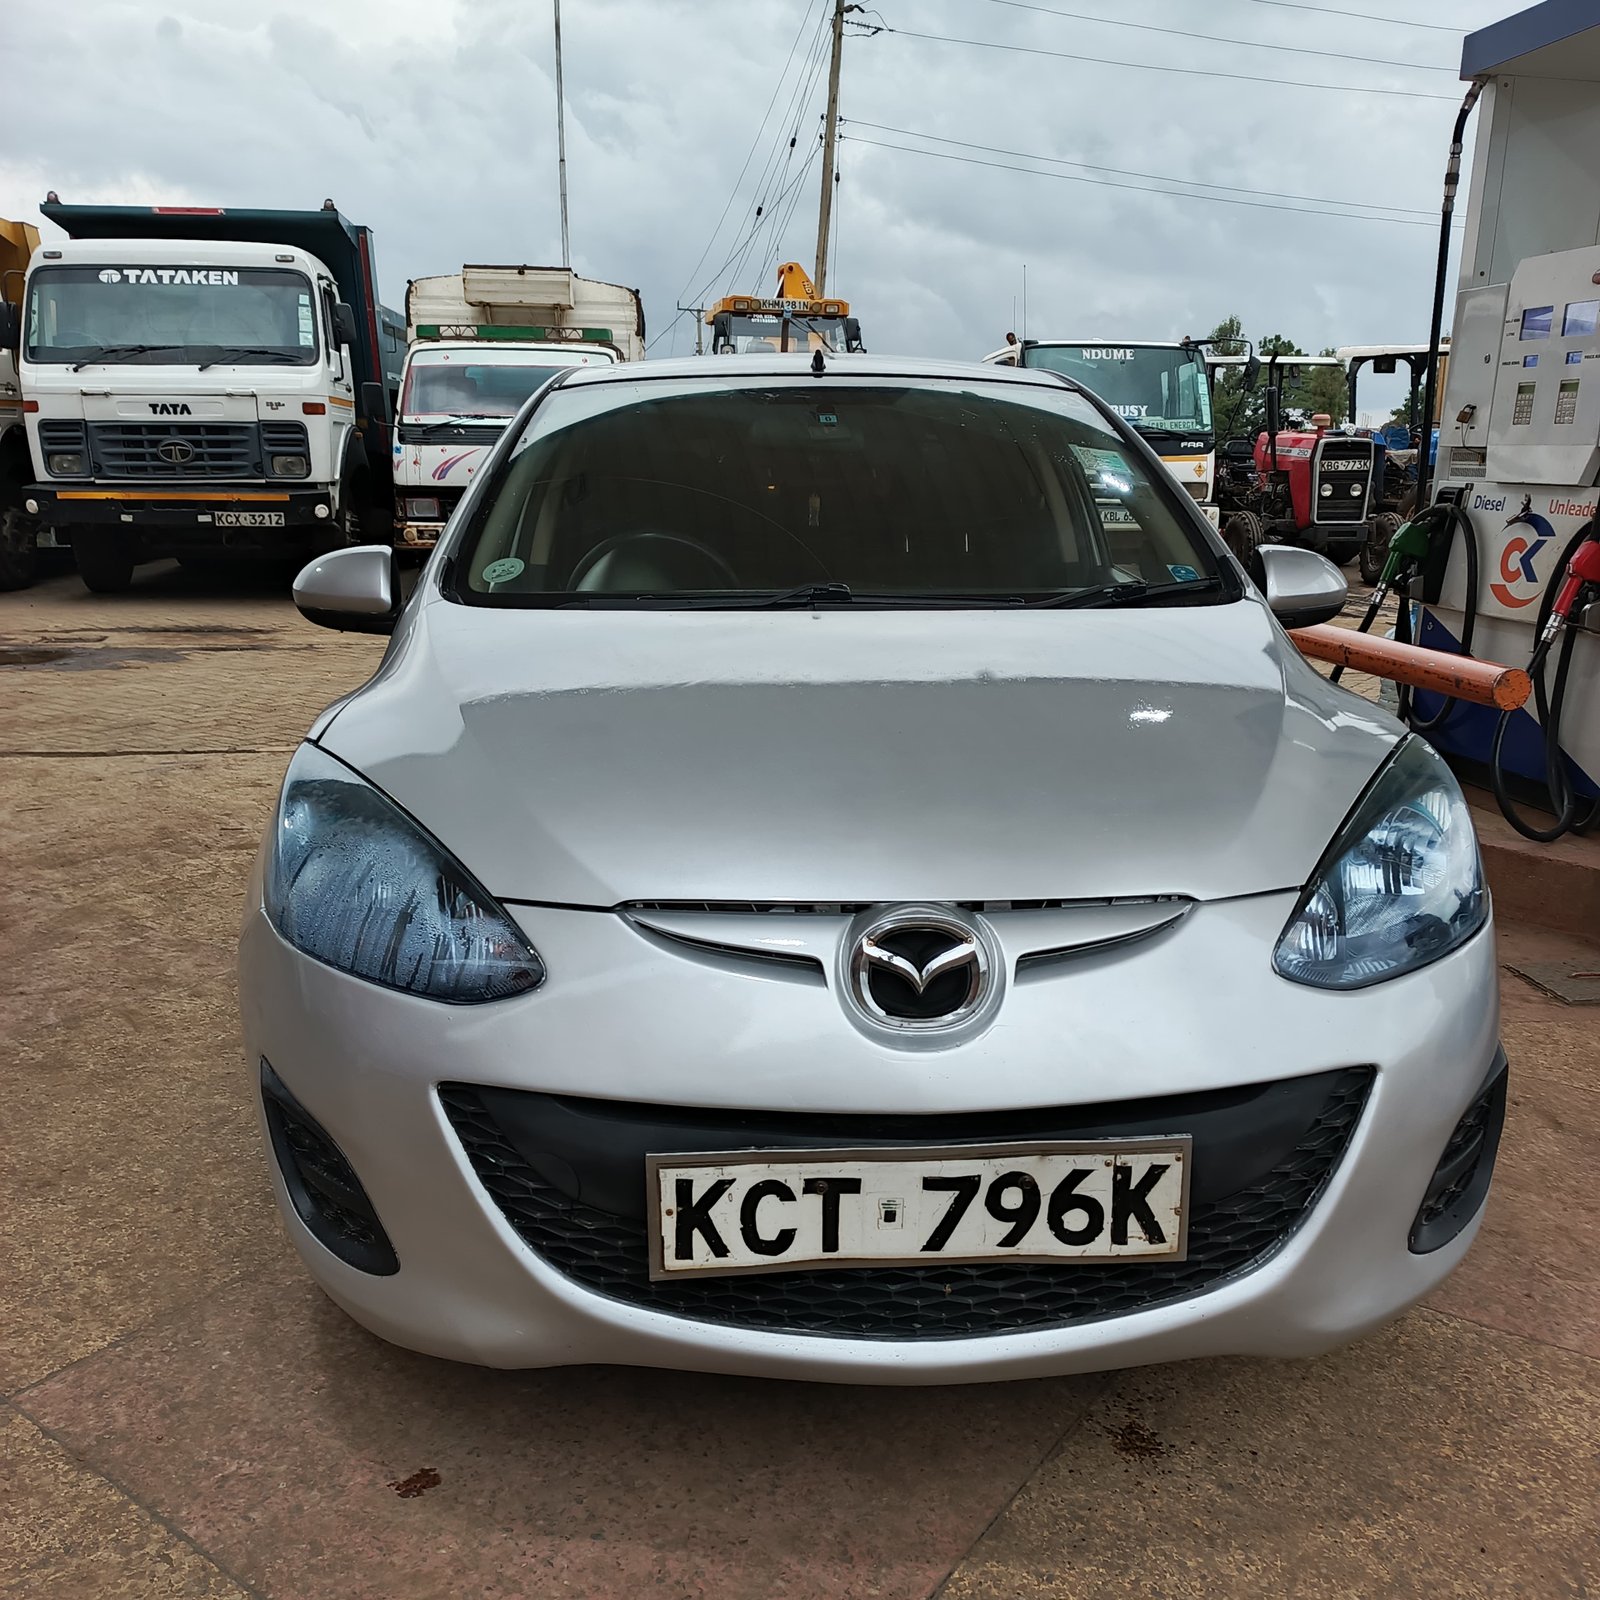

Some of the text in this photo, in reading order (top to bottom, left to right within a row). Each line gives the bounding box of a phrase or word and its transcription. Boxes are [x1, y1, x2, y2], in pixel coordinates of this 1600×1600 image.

[123, 269, 238, 285] TATAKEN
[1082, 349, 1135, 360] NDUME
[148, 403, 192, 415] TATA
[1320, 460, 1369, 471] KBG 773K
[1474, 495, 1506, 511] Diesel
[1549, 499, 1597, 518] Unleade
[216, 513, 284, 526] KCX 321Z
[1103, 511, 1120, 521] KBL
[674, 1163, 1170, 1260] KCT 796K
